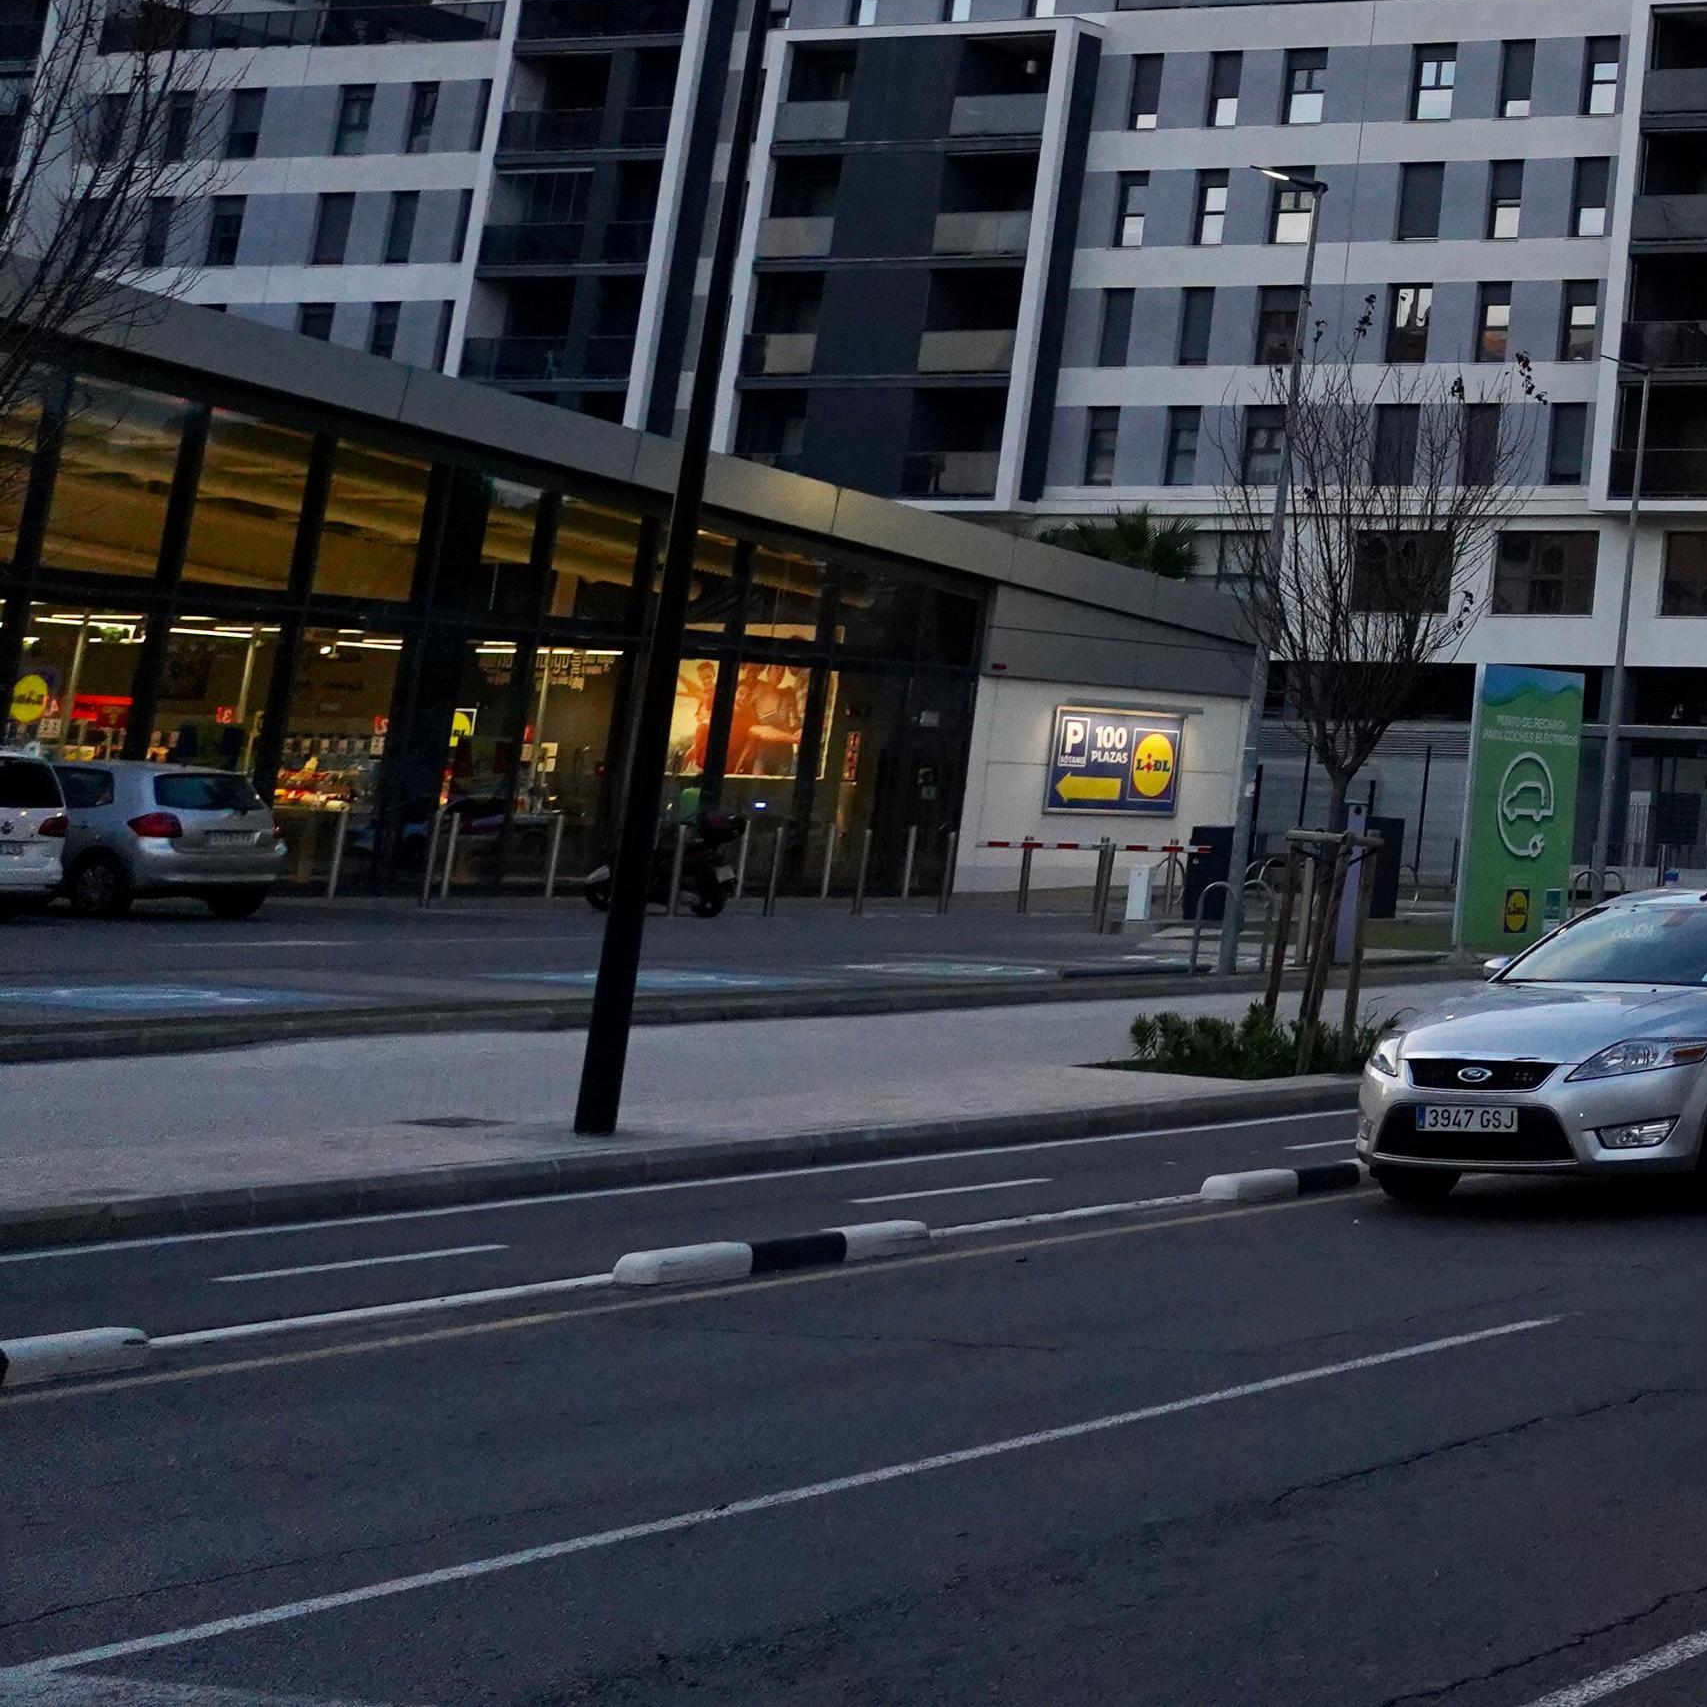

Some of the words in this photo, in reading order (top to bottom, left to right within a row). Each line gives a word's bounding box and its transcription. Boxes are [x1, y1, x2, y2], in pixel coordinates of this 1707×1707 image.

[1064, 721, 1085, 754] P
[1095, 726, 1128, 749] 100
[1091, 750, 1129, 764] PLAZAS
[1136, 753, 1171, 773] LIDL
[1428, 1108, 1475, 1129] 3947
[1480, 1110, 1515, 1130] GSJ
